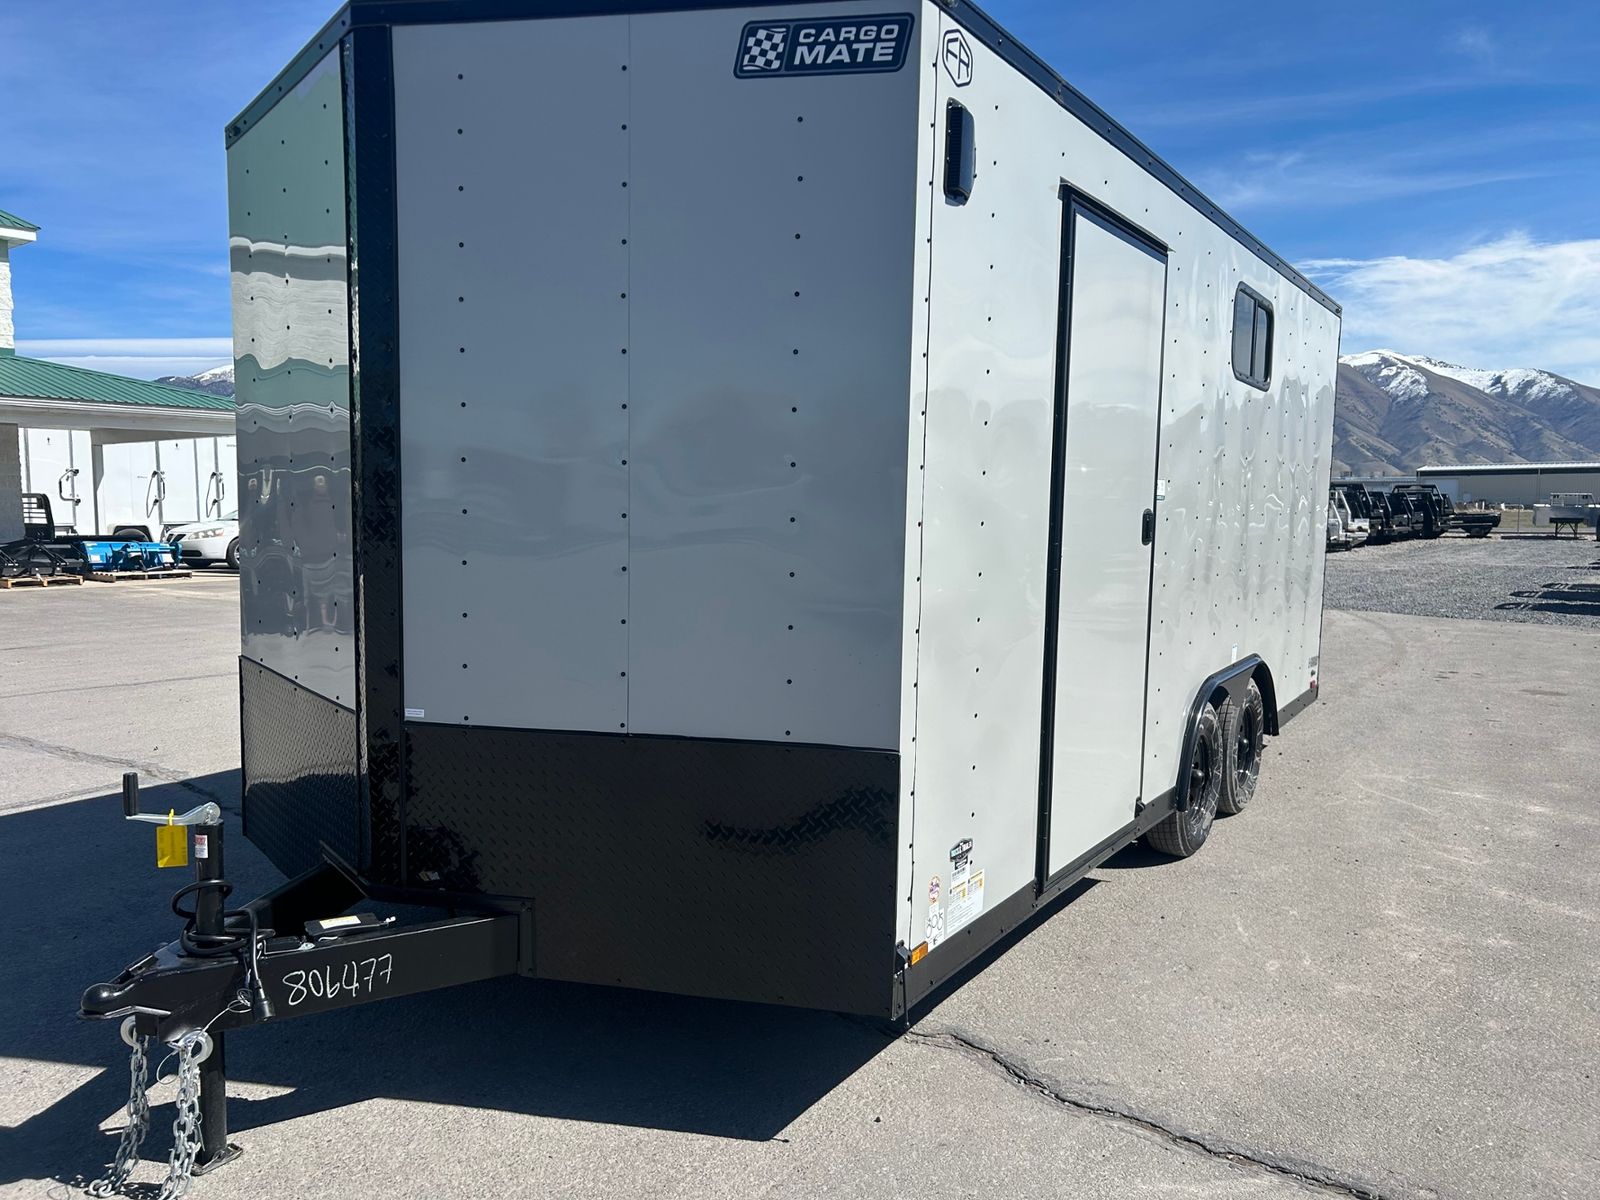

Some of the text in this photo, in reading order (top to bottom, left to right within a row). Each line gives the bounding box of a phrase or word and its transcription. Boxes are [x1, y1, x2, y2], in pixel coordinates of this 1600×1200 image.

[798, 24, 899, 43] CARGO
[793, 41, 896, 66] MATE
[282, 953, 392, 1006] 806477
